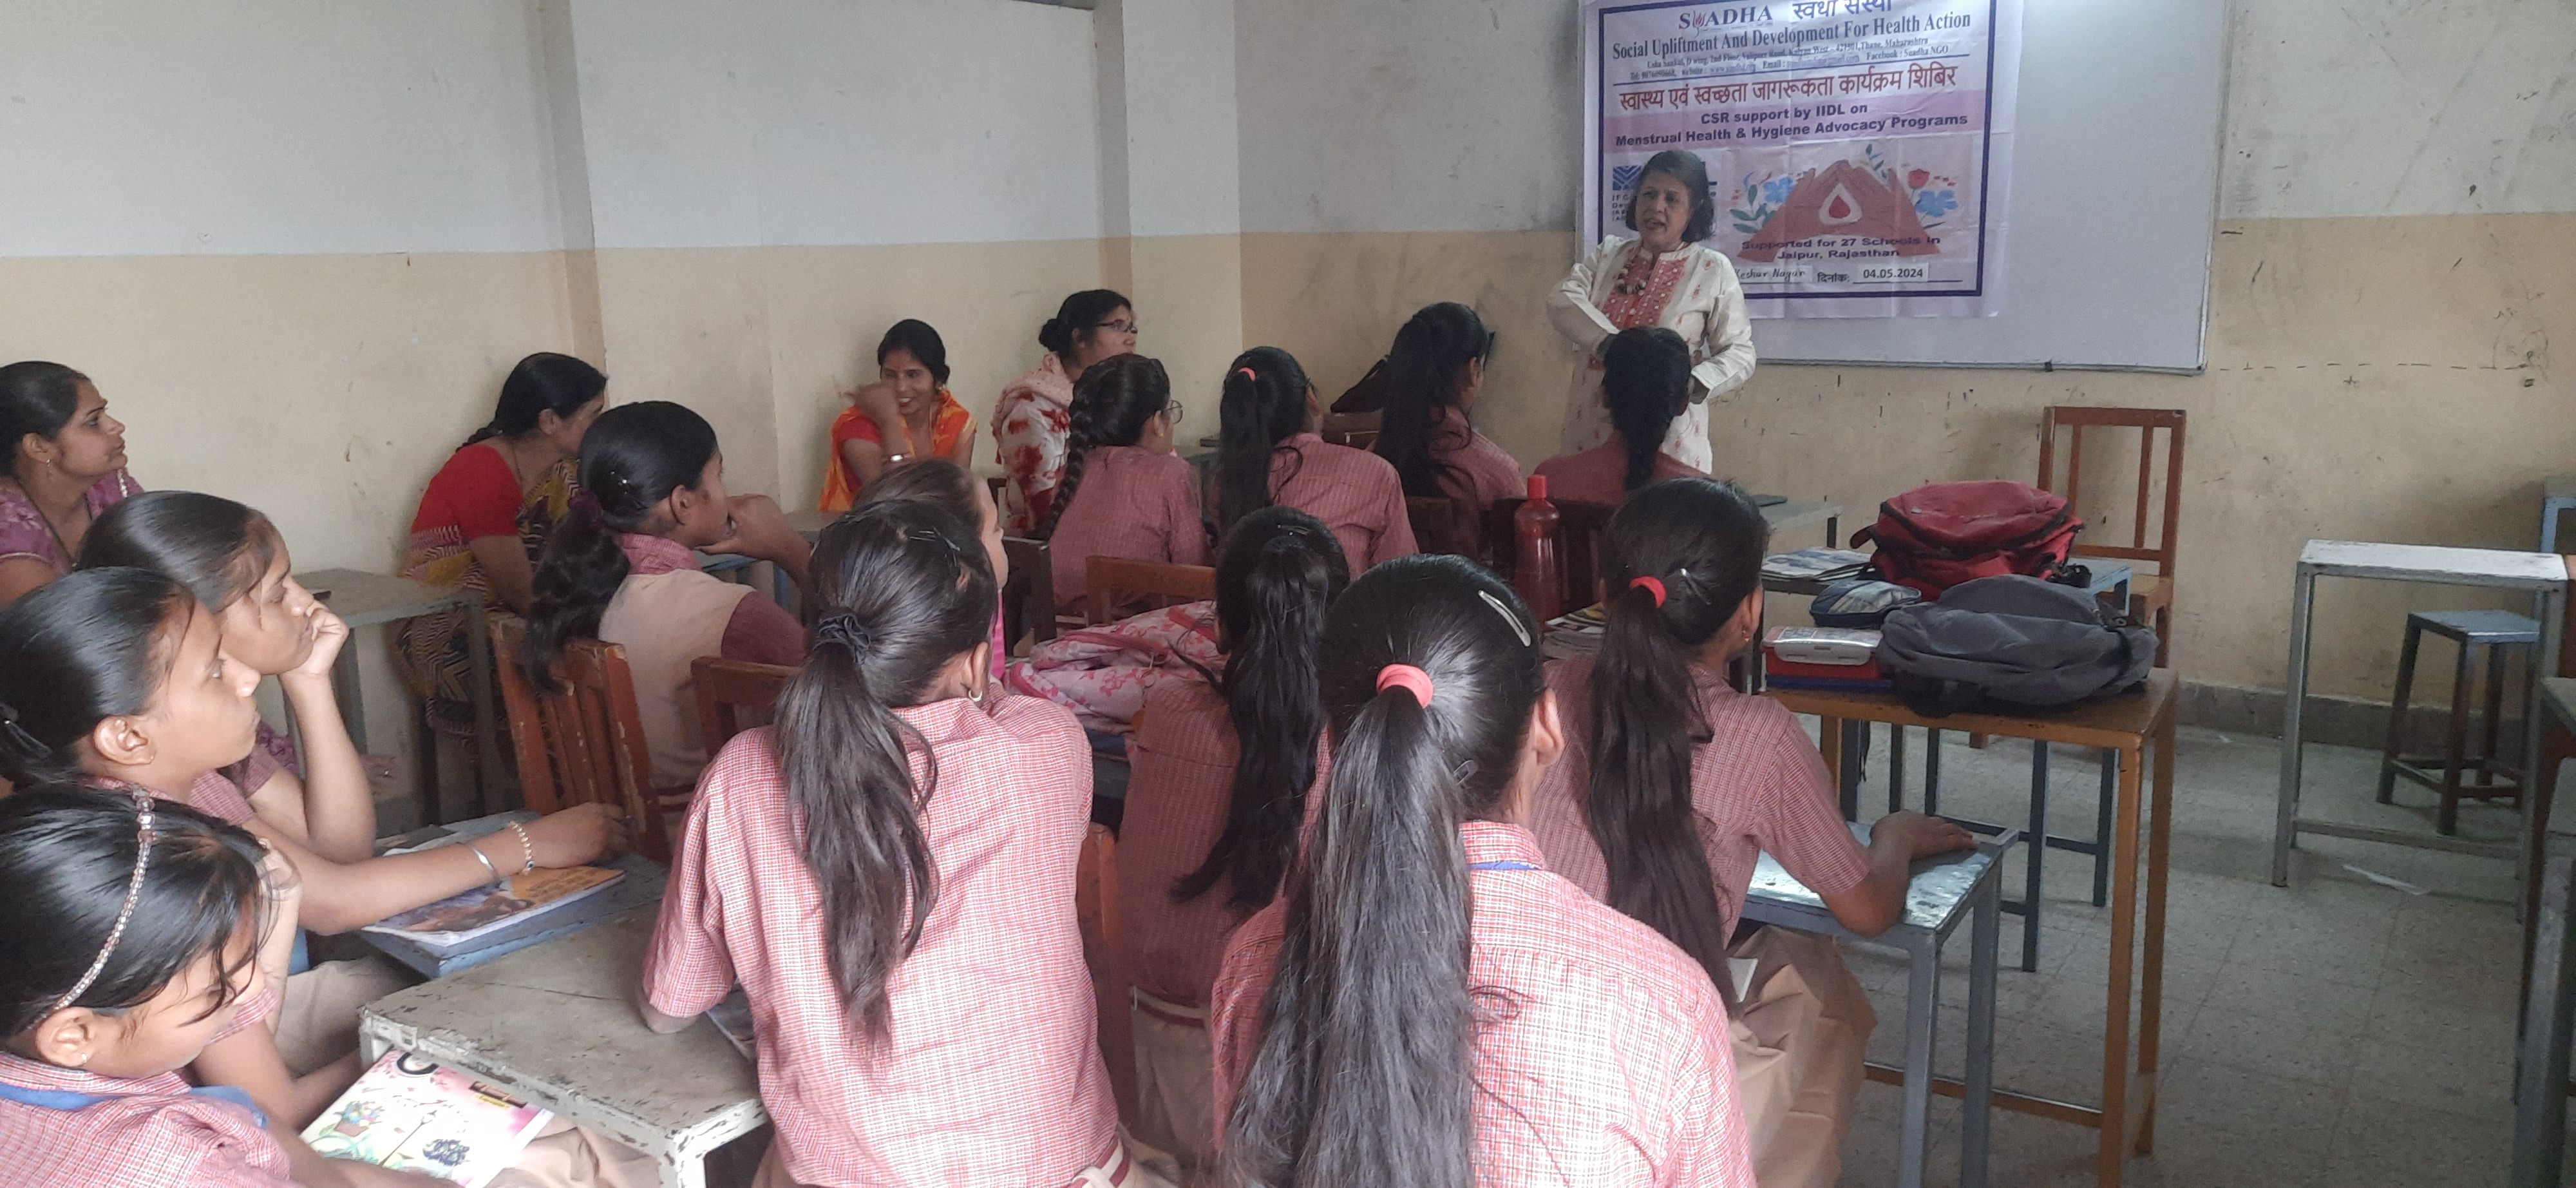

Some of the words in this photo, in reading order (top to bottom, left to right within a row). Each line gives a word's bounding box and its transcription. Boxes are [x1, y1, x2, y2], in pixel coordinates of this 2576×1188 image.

[1792, 0, 1835, 19] स्वधा
[1613, 40, 1648, 59] Social
[1652, 35, 1718, 59] Upliftment
[1721, 31, 1748, 49] And
[1752, 26, 1840, 47] Development
[1844, 21, 1869, 37] For
[1873, 15, 1920, 35] Health
[1924, 11, 1971, 31] Action
[1930, 45, 1949, 55] NGO
[1619, 90, 1665, 110] स्वास्थ्य
[1668, 84, 1690, 109] एवं
[1692, 83, 1748, 104] स्वच्छता
[1752, 76, 1835, 101] जागरूकता
[1838, 65, 1904, 94] कार्यक्रम
[1908, 61, 1958, 89] शिबिर
[1701, 112, 1730, 124] CSR
[1734, 108, 1789, 124] support
[1794, 106, 1812, 120] by
[1816, 104, 1846, 117] IIDL
[1850, 104, 1868, 114] on
[1616, 131, 1681, 146] Menstrual
[1686, 128, 1731, 142] Health
[1736, 128, 1747, 139] &
[1752, 124, 1810, 140] Hygiene
[1814, 119, 1886, 134] Advocacy
[1891, 115, 1968, 129] Programs
[1742, 239, 1812, 250] Supported
[1817, 238, 1837, 247] for
[1841, 238, 1857, 247] 27
[1862, 237, 1921, 246] Schools
[1777, 251, 1823, 260] Jaipur,
[1828, 249, 1900, 260] Rajasthan
[1772, 267, 1805, 282] Nagar
[1863, 268, 1924, 279] 04.05.2024
